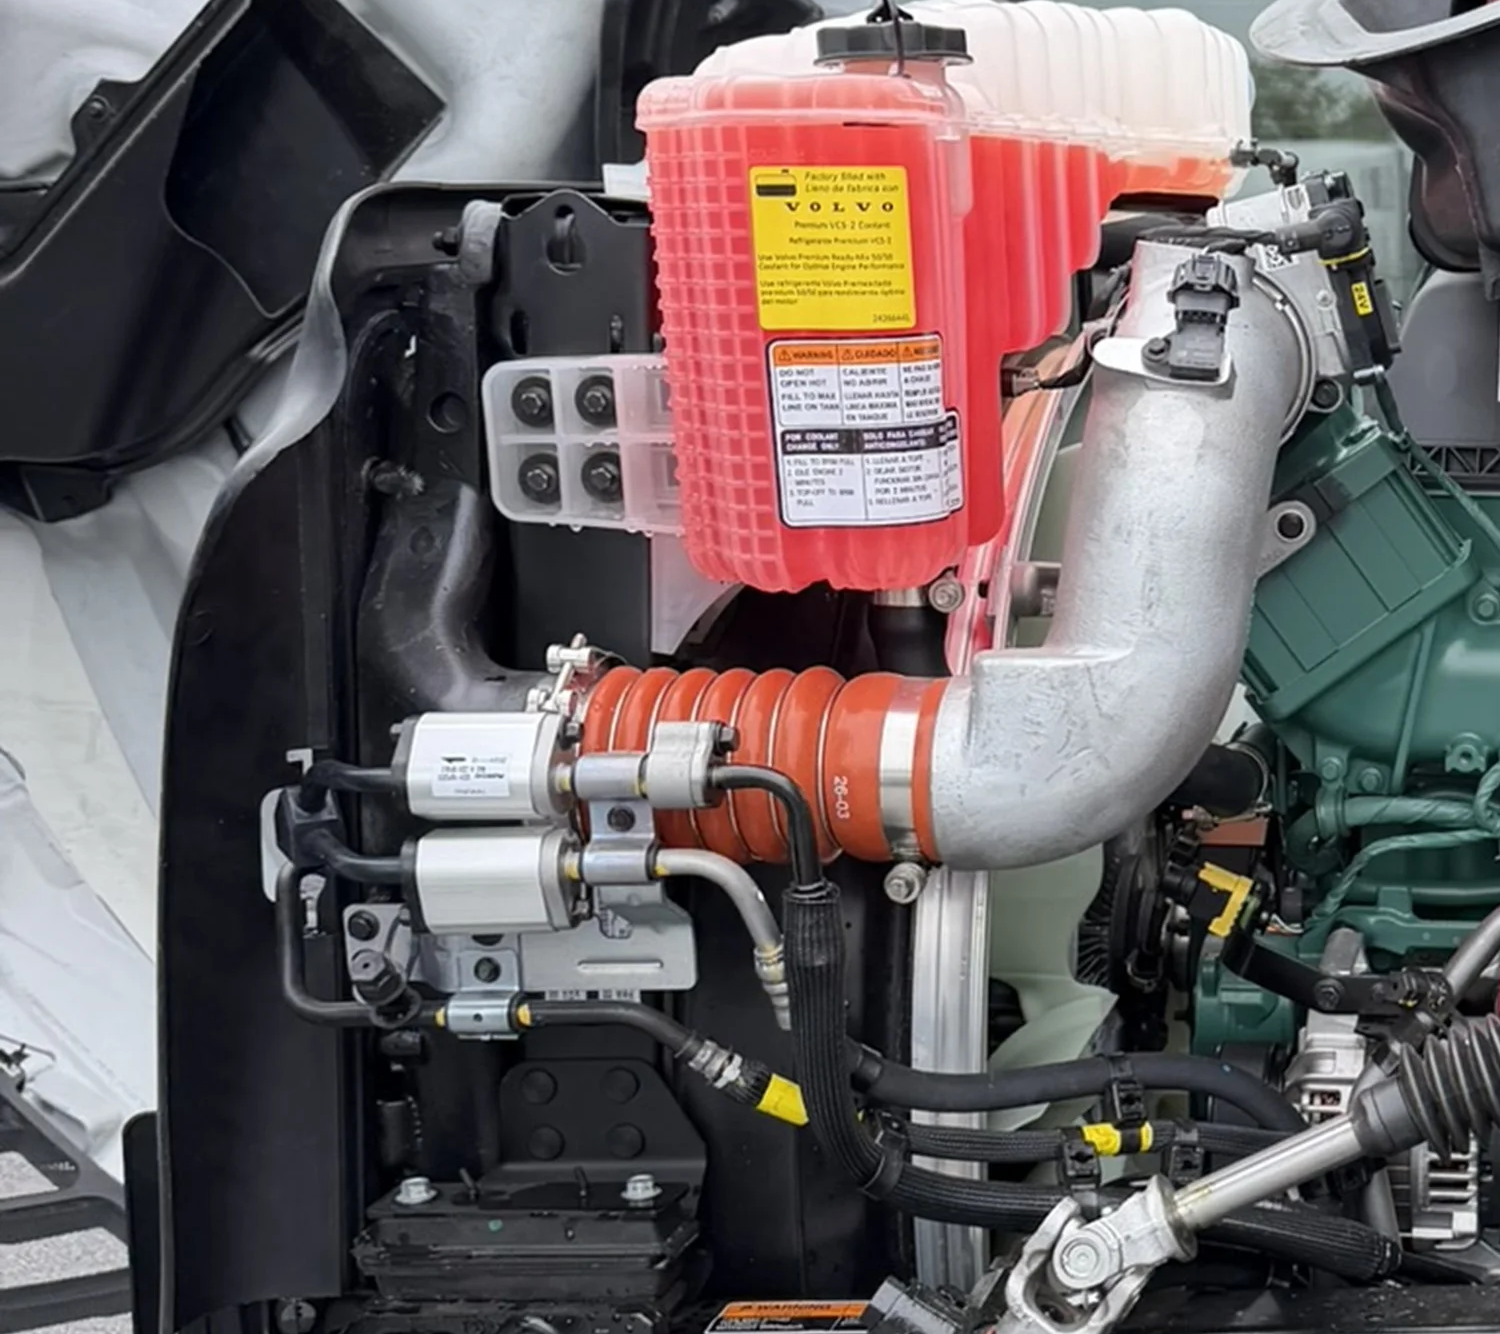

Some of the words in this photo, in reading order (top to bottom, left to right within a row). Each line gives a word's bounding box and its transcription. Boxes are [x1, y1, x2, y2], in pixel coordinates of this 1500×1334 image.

[804, 171, 837, 181] Factory
[841, 171, 864, 180] filled
[866, 171, 886, 180] with
[832, 183, 844, 192] de
[784, 201, 895, 213] VOLVO
[794, 221, 828, 230] Premium
[1353, 285, 1370, 309] 24V
[792, 350, 833, 360] WARNING
[855, 348, 896, 359] CUIDADO
[779, 369, 794, 377] DO
[810, 379, 827, 387] HOT
[843, 378, 857, 386] NO
[858, 378, 887, 386] ABRIR
[781, 393, 801, 401] FILL
[785, 433, 802, 441] FOR
